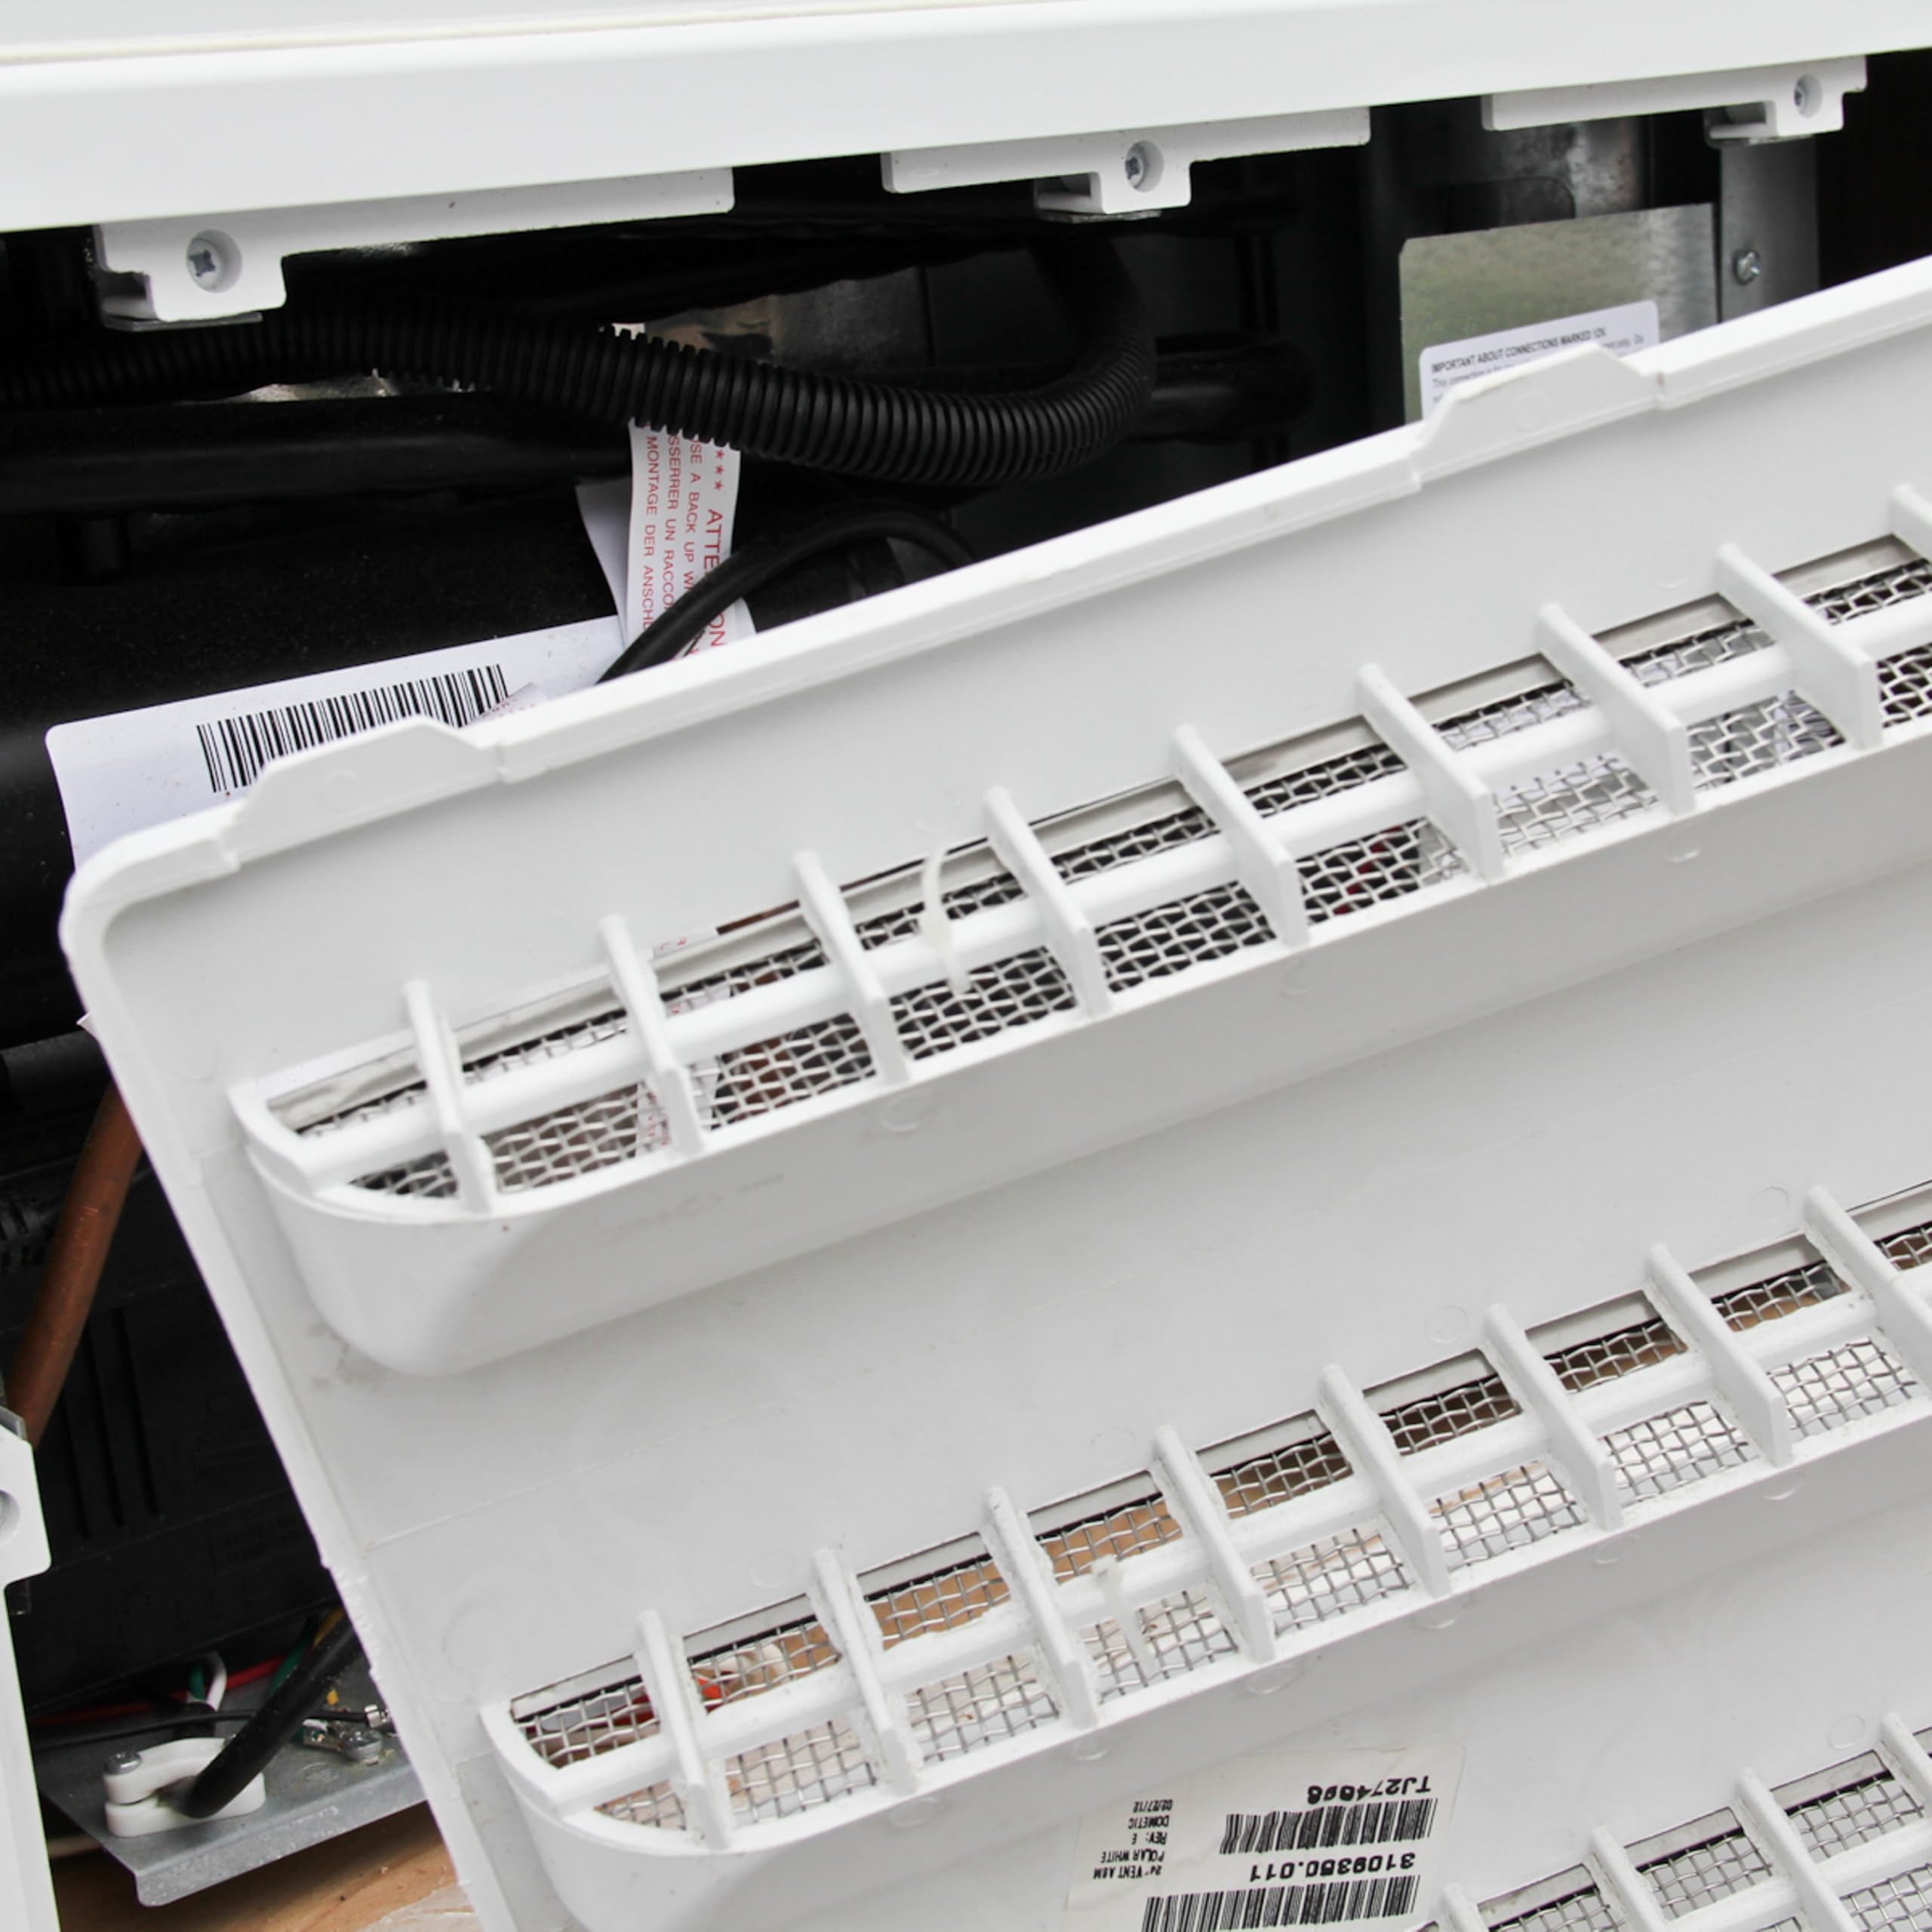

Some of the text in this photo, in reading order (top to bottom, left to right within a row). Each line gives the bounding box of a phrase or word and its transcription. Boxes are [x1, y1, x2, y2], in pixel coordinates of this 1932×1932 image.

[1431, 354, 1475, 374] IMPORTANT
[1477, 348, 1503, 363] ABOUT
[1505, 337, 1558, 359] CONNECTIONS
[1560, 330, 1591, 345] MARKED
[646, 436, 660, 516] MONTAGE
[690, 472, 701, 484] A
[685, 492, 699, 534] BACK
[644, 524, 656, 557] DER
[665, 518, 677, 541] UN
[683, 541, 694, 563] UP
[1128, 1815, 1169, 1829] DOMETIC
[1131, 1832, 1167, 1845] REV: E
[1100, 1848, 1164, 1863] POLAR WHITE
[1118, 1866, 1142, 1879] VENT
[1250, 1853, 1416, 1881] 3109350.011
